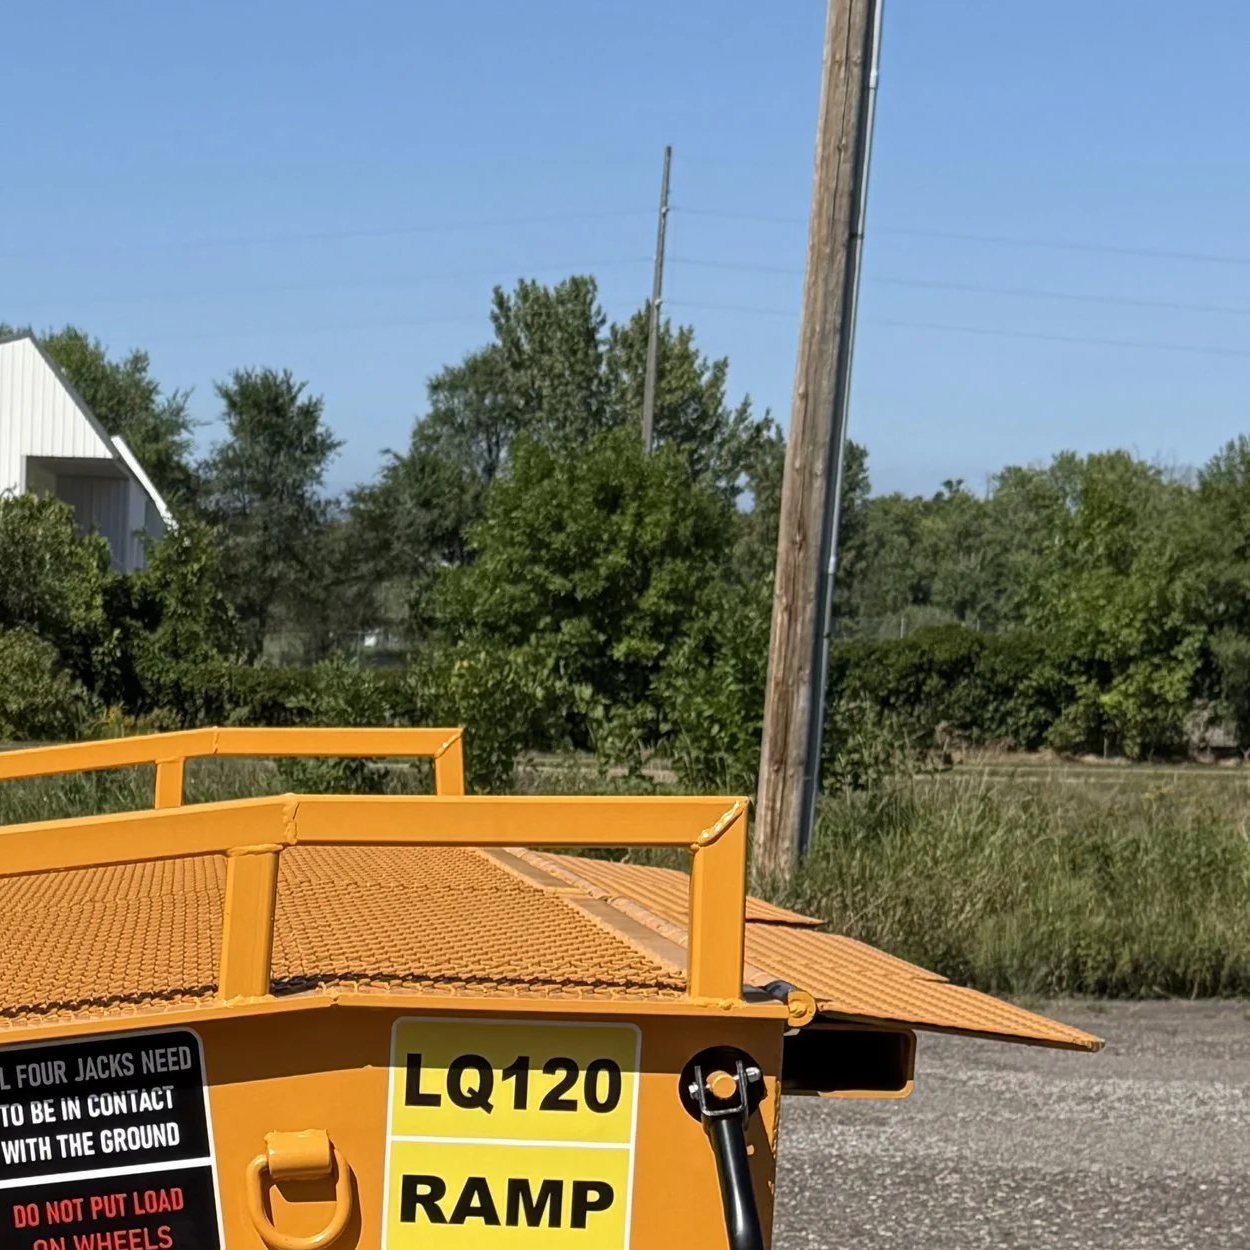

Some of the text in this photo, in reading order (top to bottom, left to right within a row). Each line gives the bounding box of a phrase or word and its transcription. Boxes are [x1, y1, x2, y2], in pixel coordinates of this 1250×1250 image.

[16, 1060, 68, 1088] FOUR
[74, 1052, 135, 1082] JACKS
[140, 1046, 192, 1074] NEED
[404, 1053, 622, 1114] LQ120
[30, 1099, 57, 1125] BE
[61, 1096, 81, 1121] IN
[87, 1085, 174, 1118] CONTACT
[1, 1122, 180, 1165] WITH THE GROUND
[13, 1187, 184, 1229] DO NOT PUT LOAD
[400, 1174, 615, 1229] RAMP
